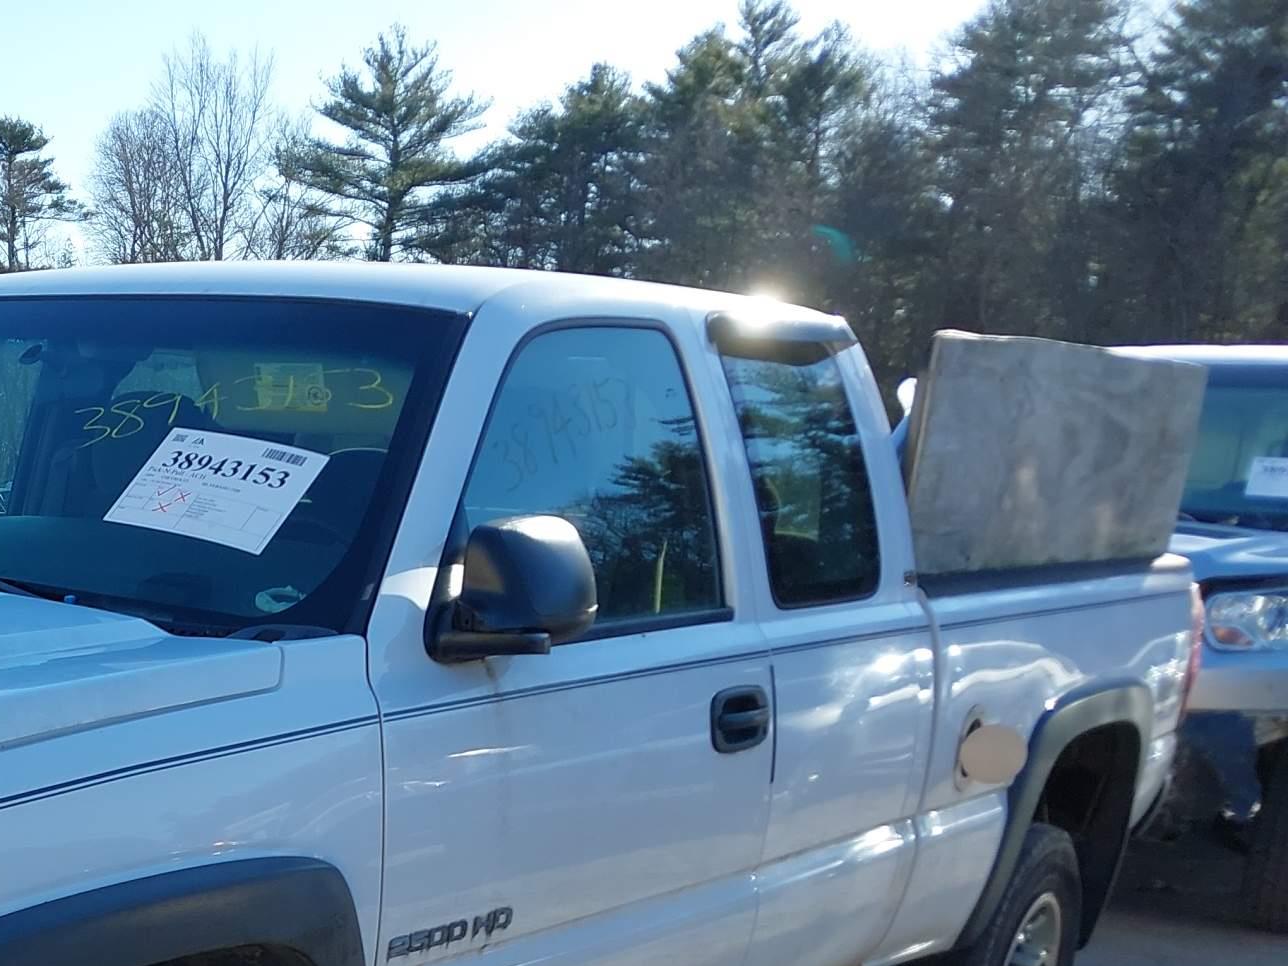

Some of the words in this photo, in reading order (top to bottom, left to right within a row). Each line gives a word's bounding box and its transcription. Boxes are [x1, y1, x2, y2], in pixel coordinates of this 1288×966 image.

[162, 450, 291, 489] 38943153
[387, 919, 468, 960] 2500
[472, 907, 513, 937] HD
